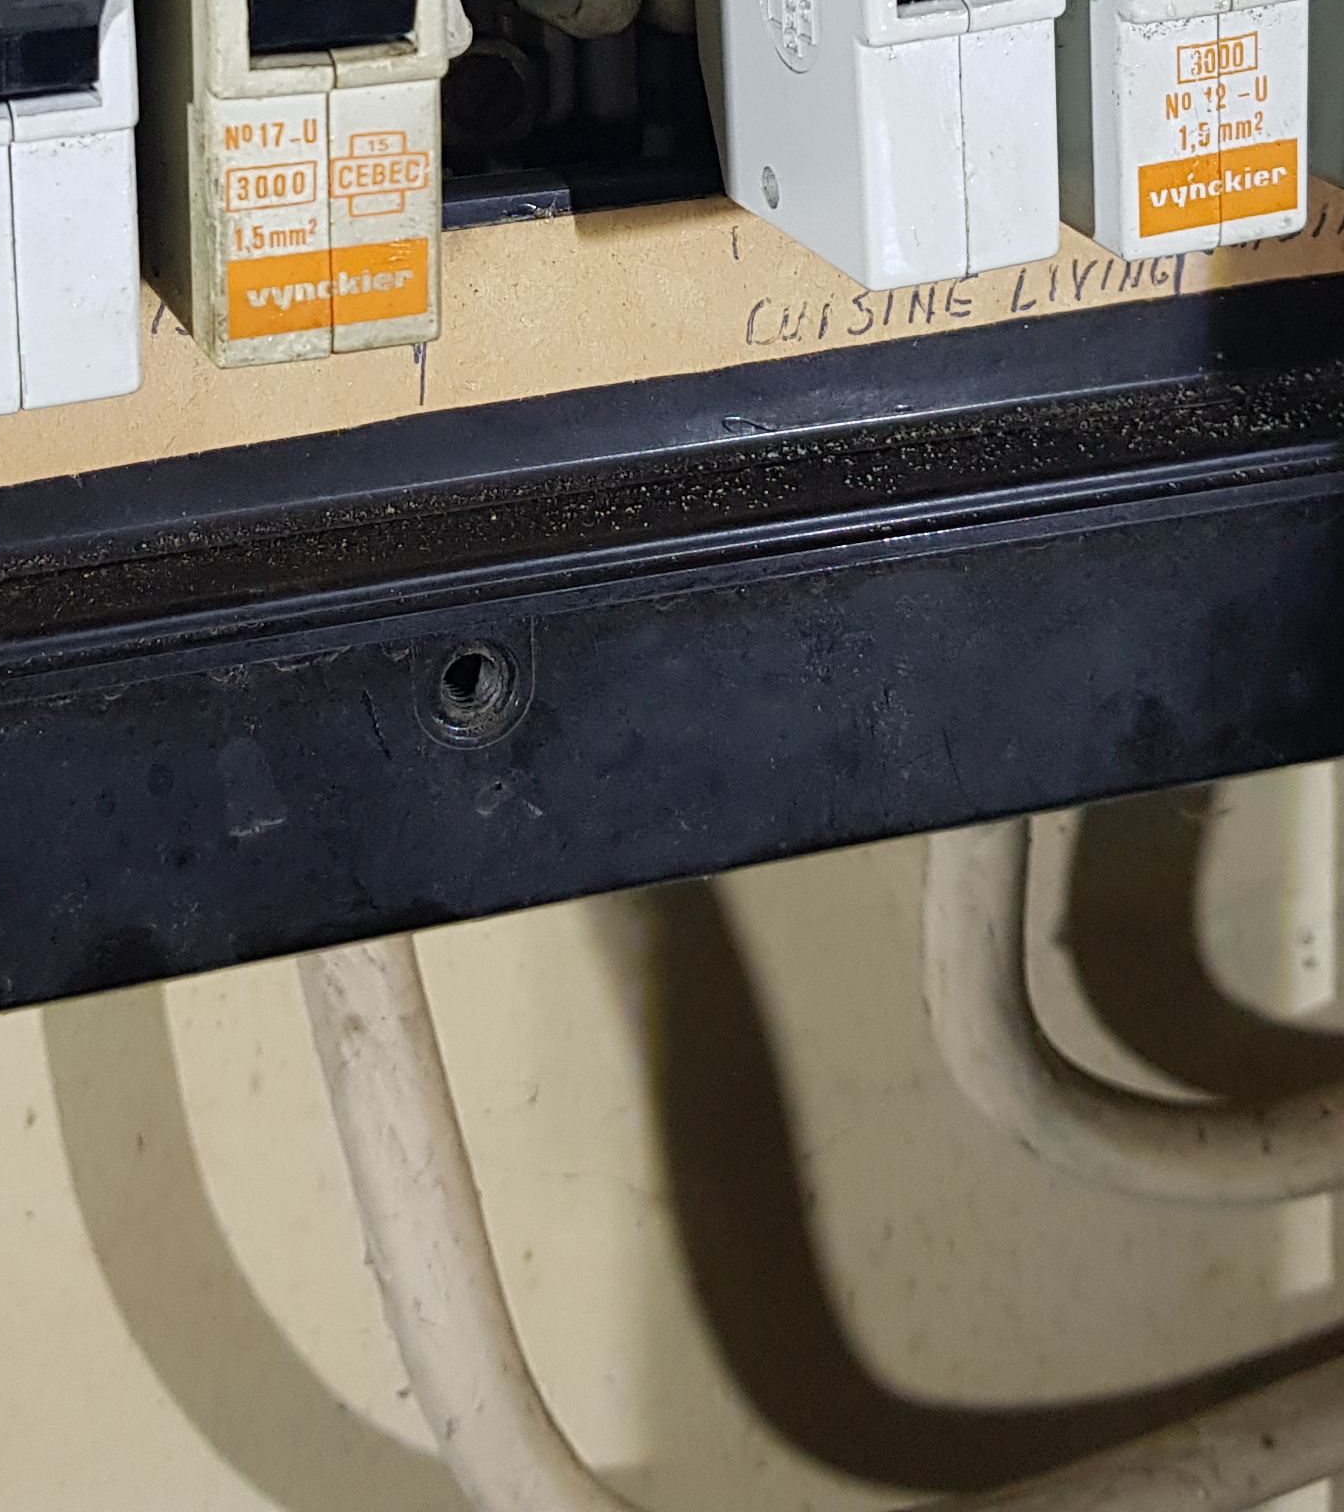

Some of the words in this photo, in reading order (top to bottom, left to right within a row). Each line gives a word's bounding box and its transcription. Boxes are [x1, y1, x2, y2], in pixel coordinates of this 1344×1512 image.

[1191, 41, 1244, 76] 3000
[238, 172, 305, 200] 3000
[339, 160, 420, 189] CEBEC
[1149, 166, 1288, 208] vynckier
[246, 268, 414, 310] vynckier
